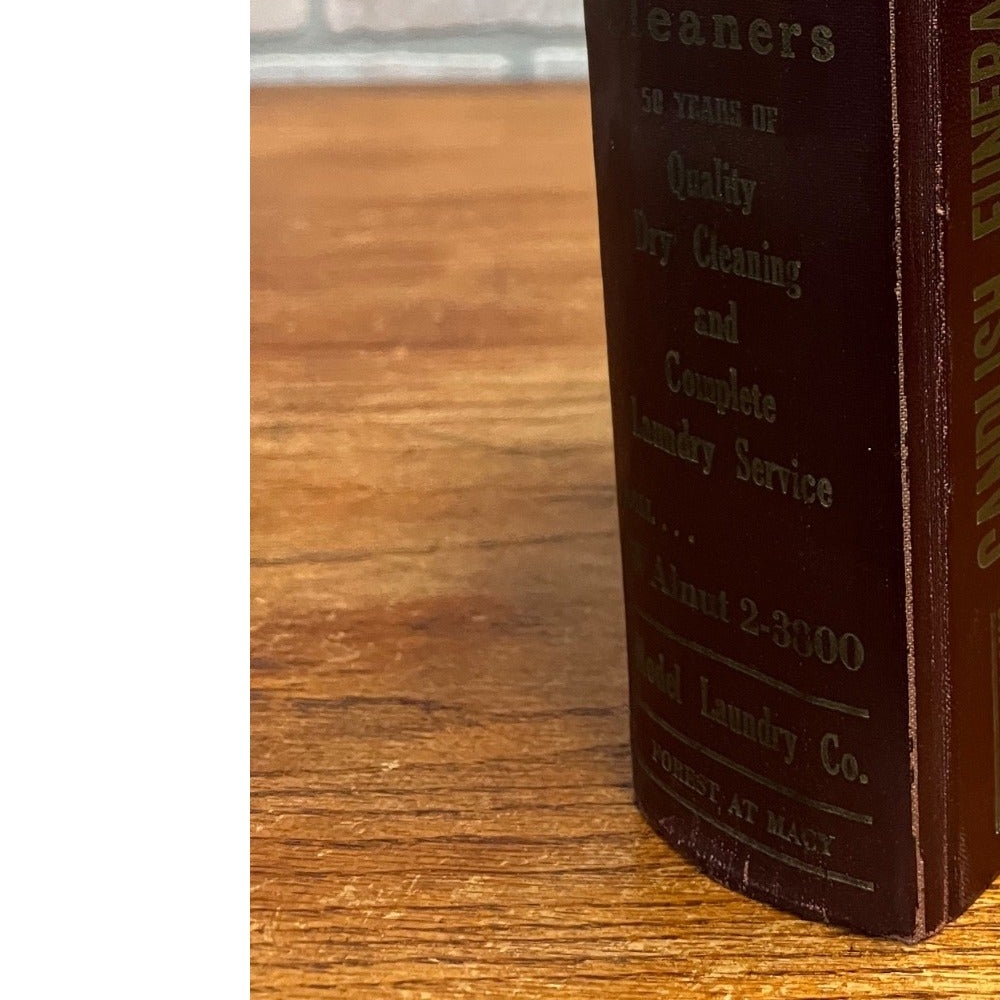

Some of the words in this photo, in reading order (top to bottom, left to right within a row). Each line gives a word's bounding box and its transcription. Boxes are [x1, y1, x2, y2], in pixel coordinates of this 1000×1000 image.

[641, 86, 665, 115] 50
[672, 91, 743, 128] YEARS
[752, 103, 778, 135] OF
[666, 149, 757, 216] Quality
[631, 207, 673, 268] Dry
[692, 222, 802, 300] Cleaning
[693, 301, 740, 344] and
[663, 349, 777, 424] Complete
[629, 394, 716, 476] Laundry
[734, 437, 834, 509] Service
[700, 675, 798, 766] Laundry
[819, 732, 870, 785] Co.
[650, 738, 721, 804] FOREST
[726, 793, 759, 825] AT
[766, 809, 837, 857] MACY
